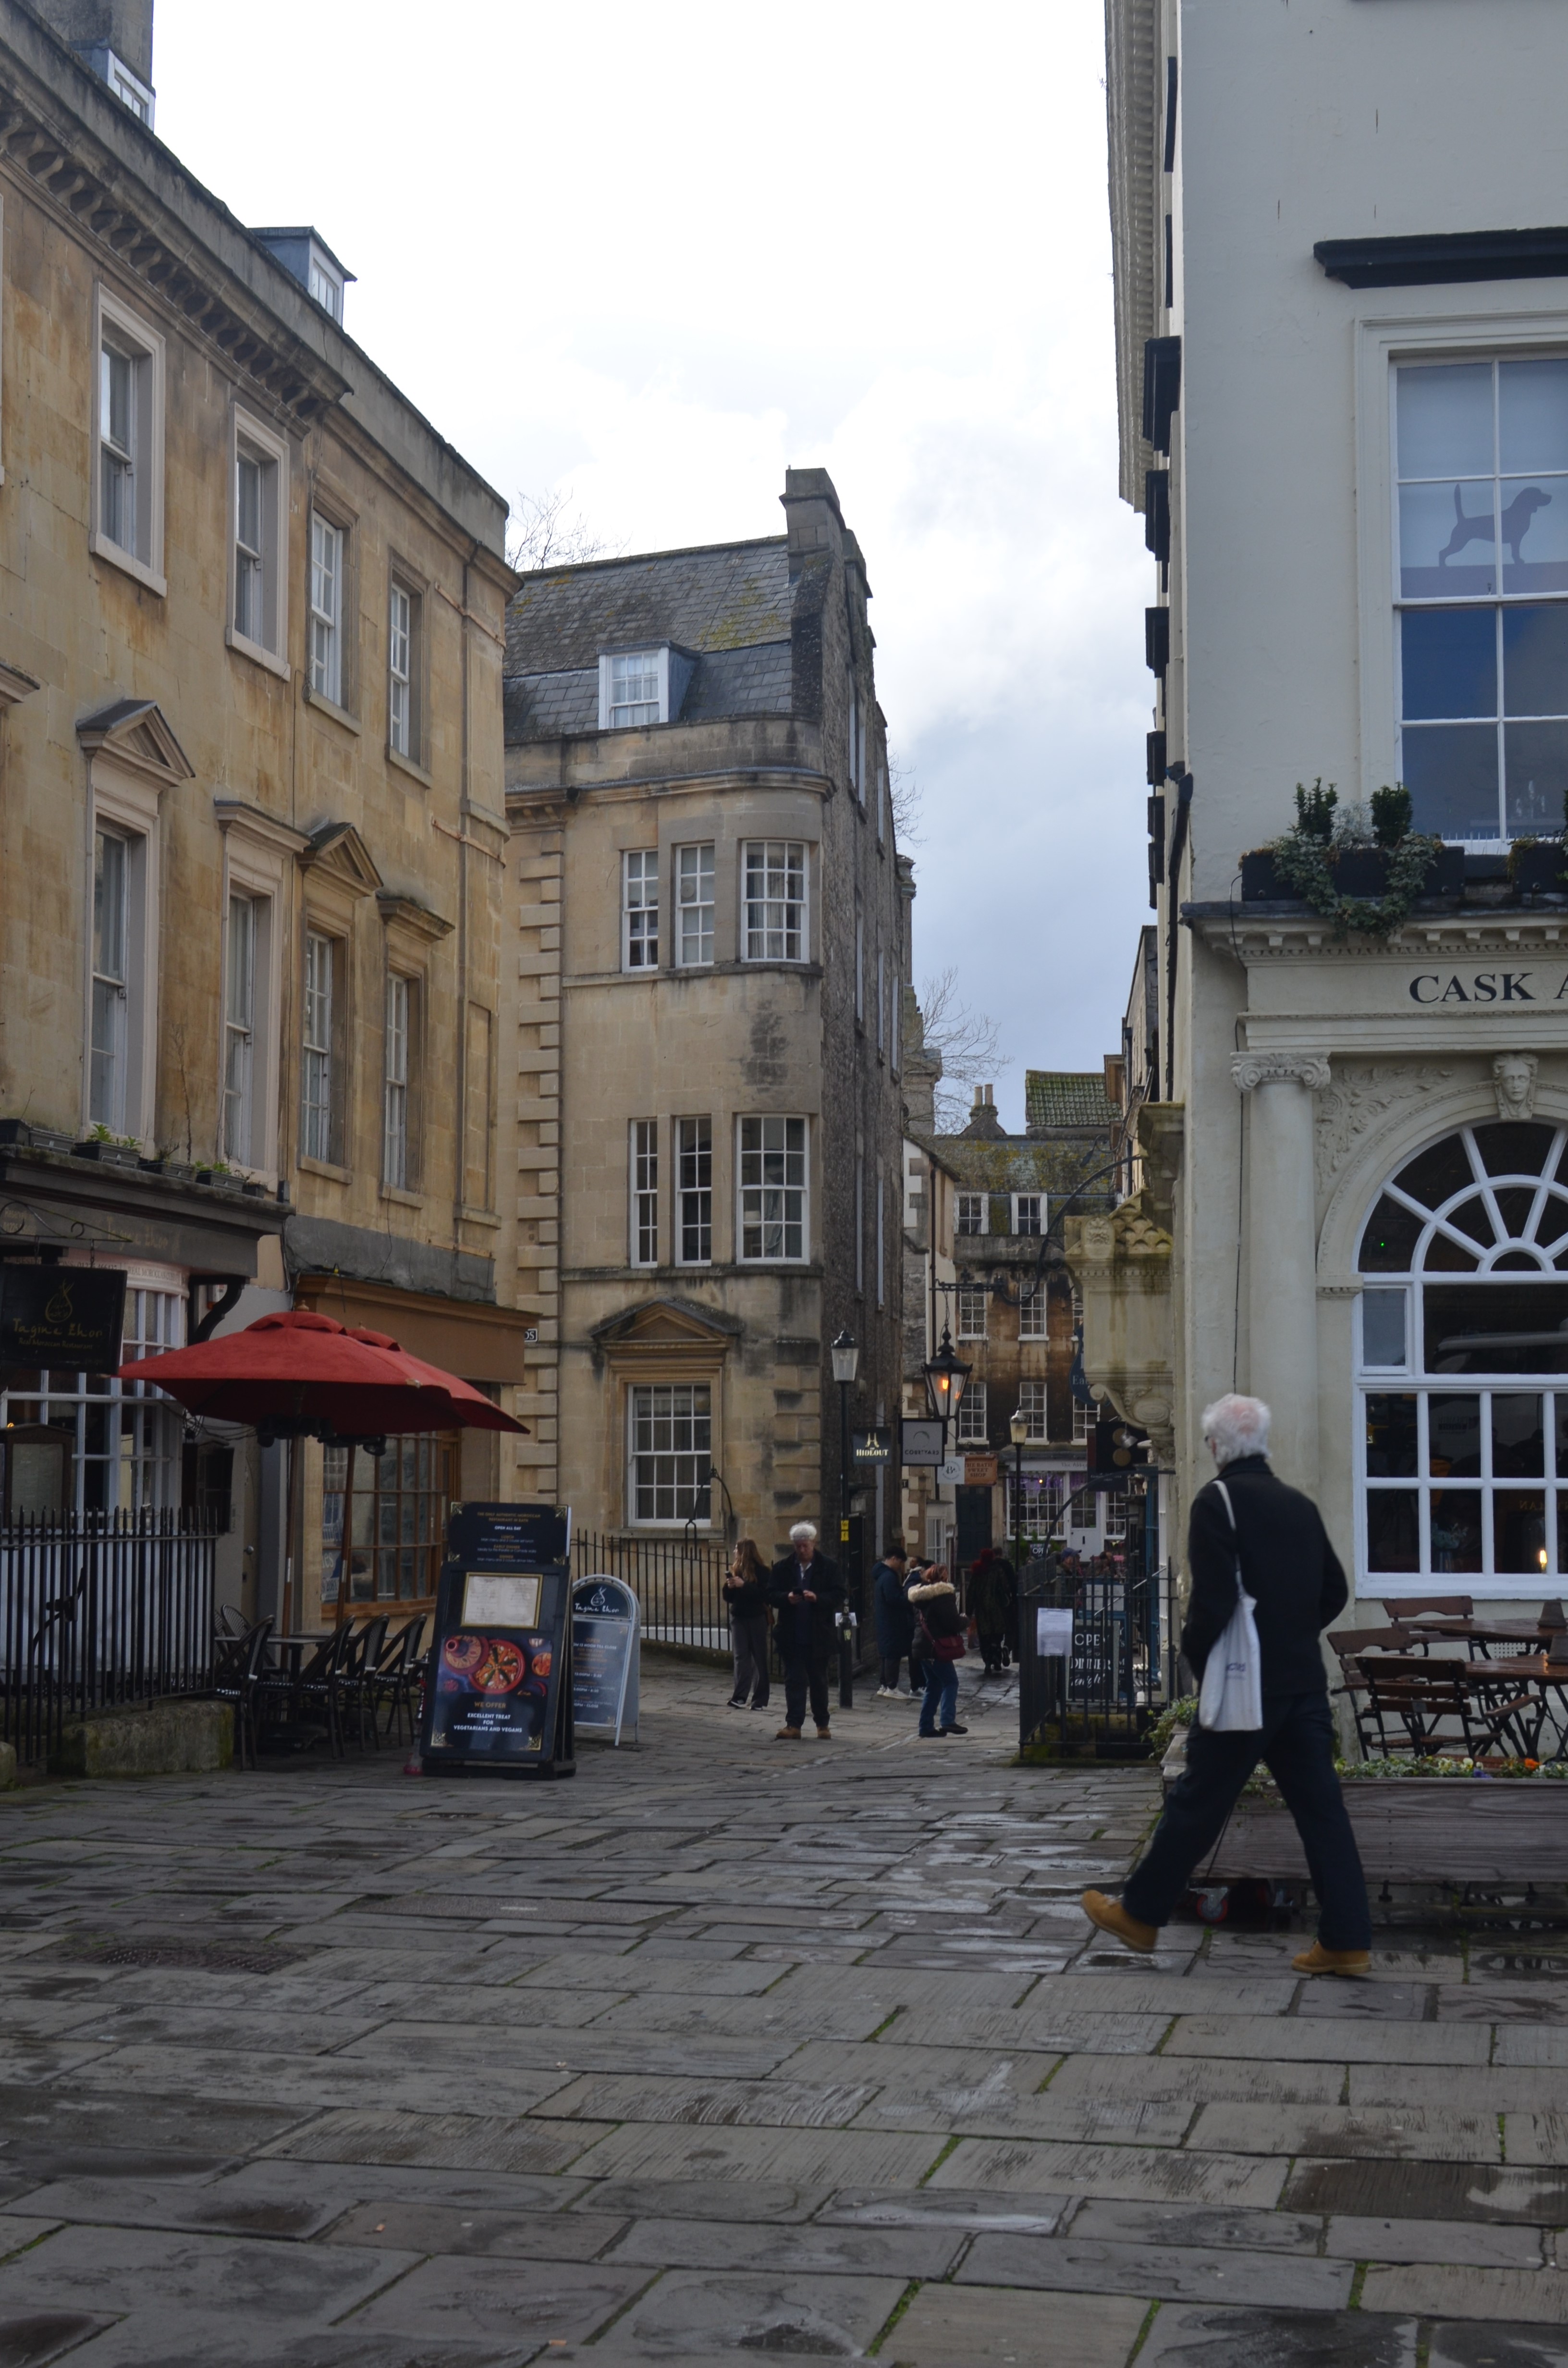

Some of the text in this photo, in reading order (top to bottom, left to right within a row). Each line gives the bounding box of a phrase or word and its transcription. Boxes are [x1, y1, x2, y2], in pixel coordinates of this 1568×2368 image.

[1409, 973, 1536, 1003] CASK
[12, 1318, 62, 1339] Tagine
[18, 1337, 93, 1350] Real Moroccan Restaurant
[575, 1603, 600, 1613] Tagine
